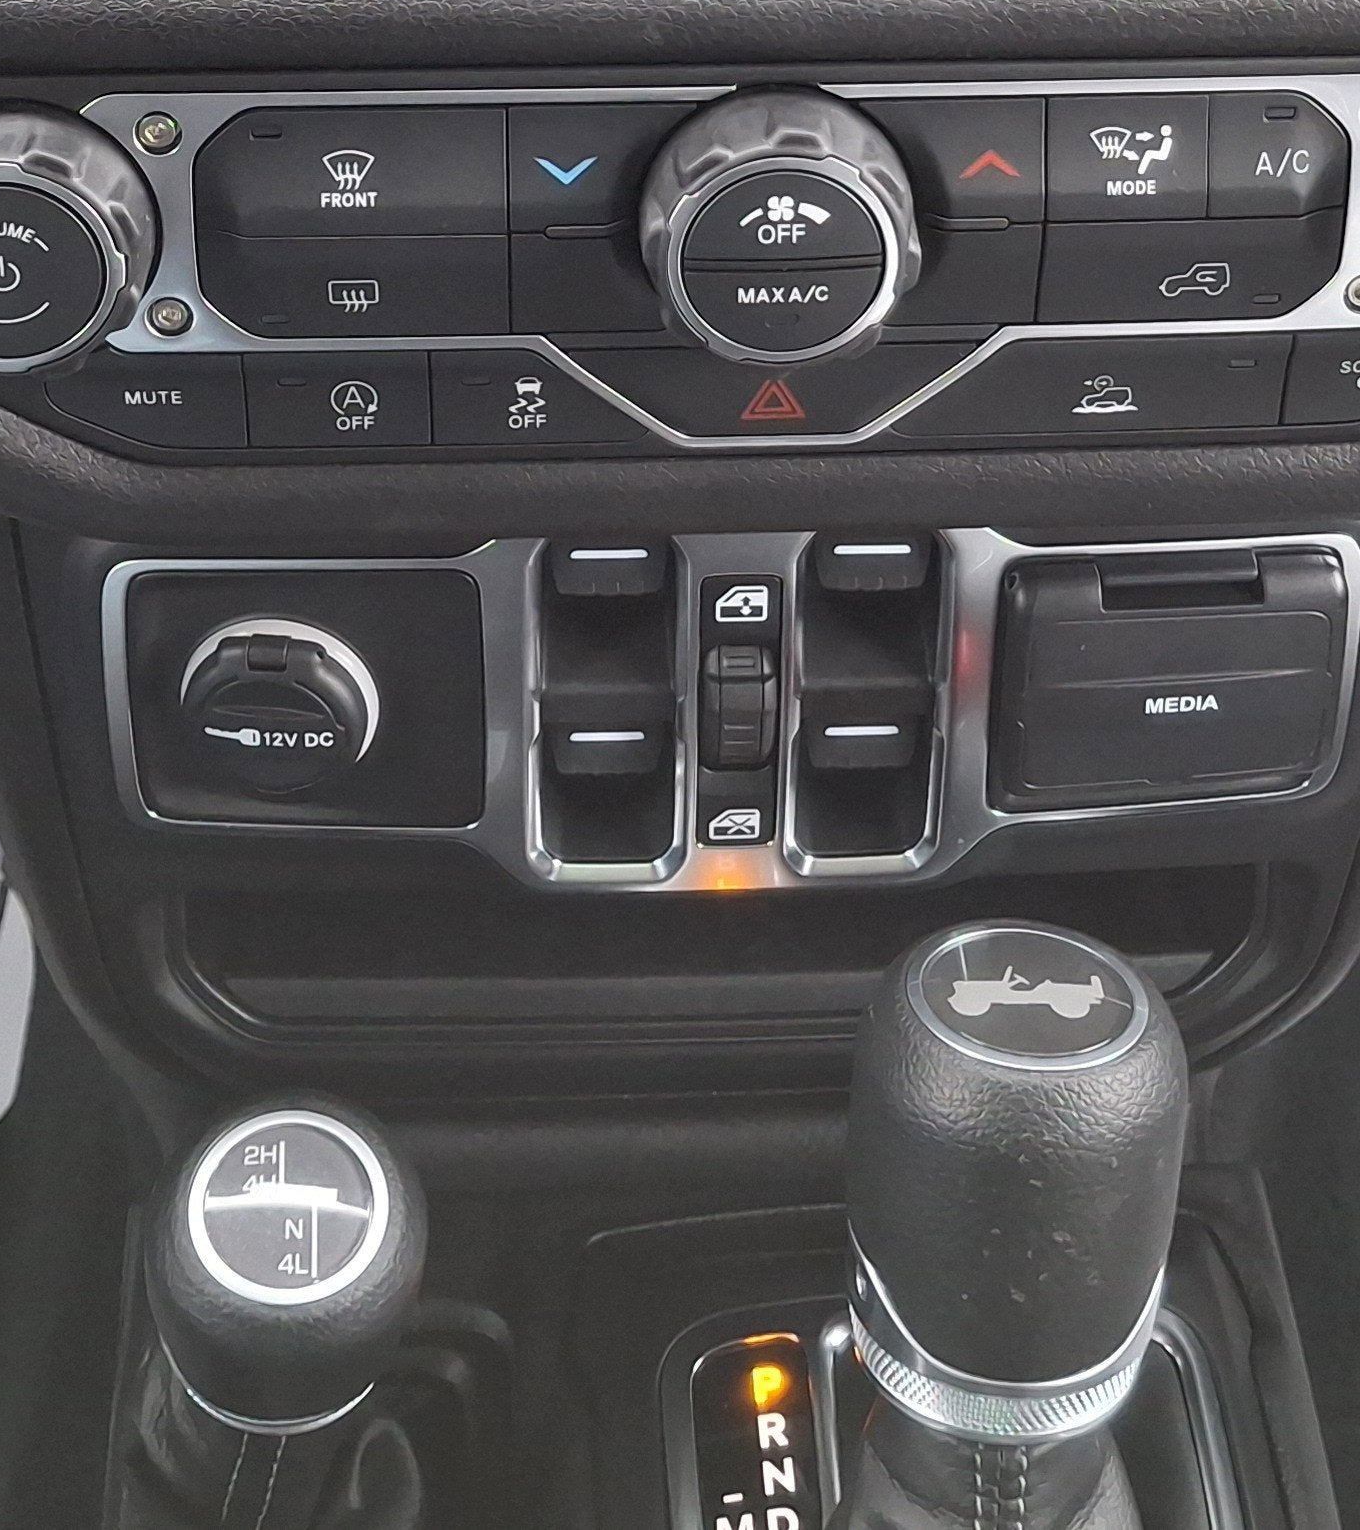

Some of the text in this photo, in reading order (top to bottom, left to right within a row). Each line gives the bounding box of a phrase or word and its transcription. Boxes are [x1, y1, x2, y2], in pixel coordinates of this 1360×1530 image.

[1255, 150, 1310, 177] A/C
[1106, 179, 1157, 196] MODE
[320, 191, 378, 208] FRONT
[757, 223, 806, 245] OFF
[737, 283, 829, 305] MAX A/C
[124, 390, 183, 406] MUTE
[336, 416, 375, 431] OFF
[508, 413, 547, 430] OFF
[1144, 694, 1219, 714] MEDIA
[263, 731, 335, 748] 12V DC
[243, 1144, 277, 1166] 2H
[285, 1218, 303, 1240] N
[277, 1253, 309, 1275] 4L
[752, 1366, 783, 1408] P
[757, 1412, 789, 1449] R
[762, 1456, 796, 1497] N
